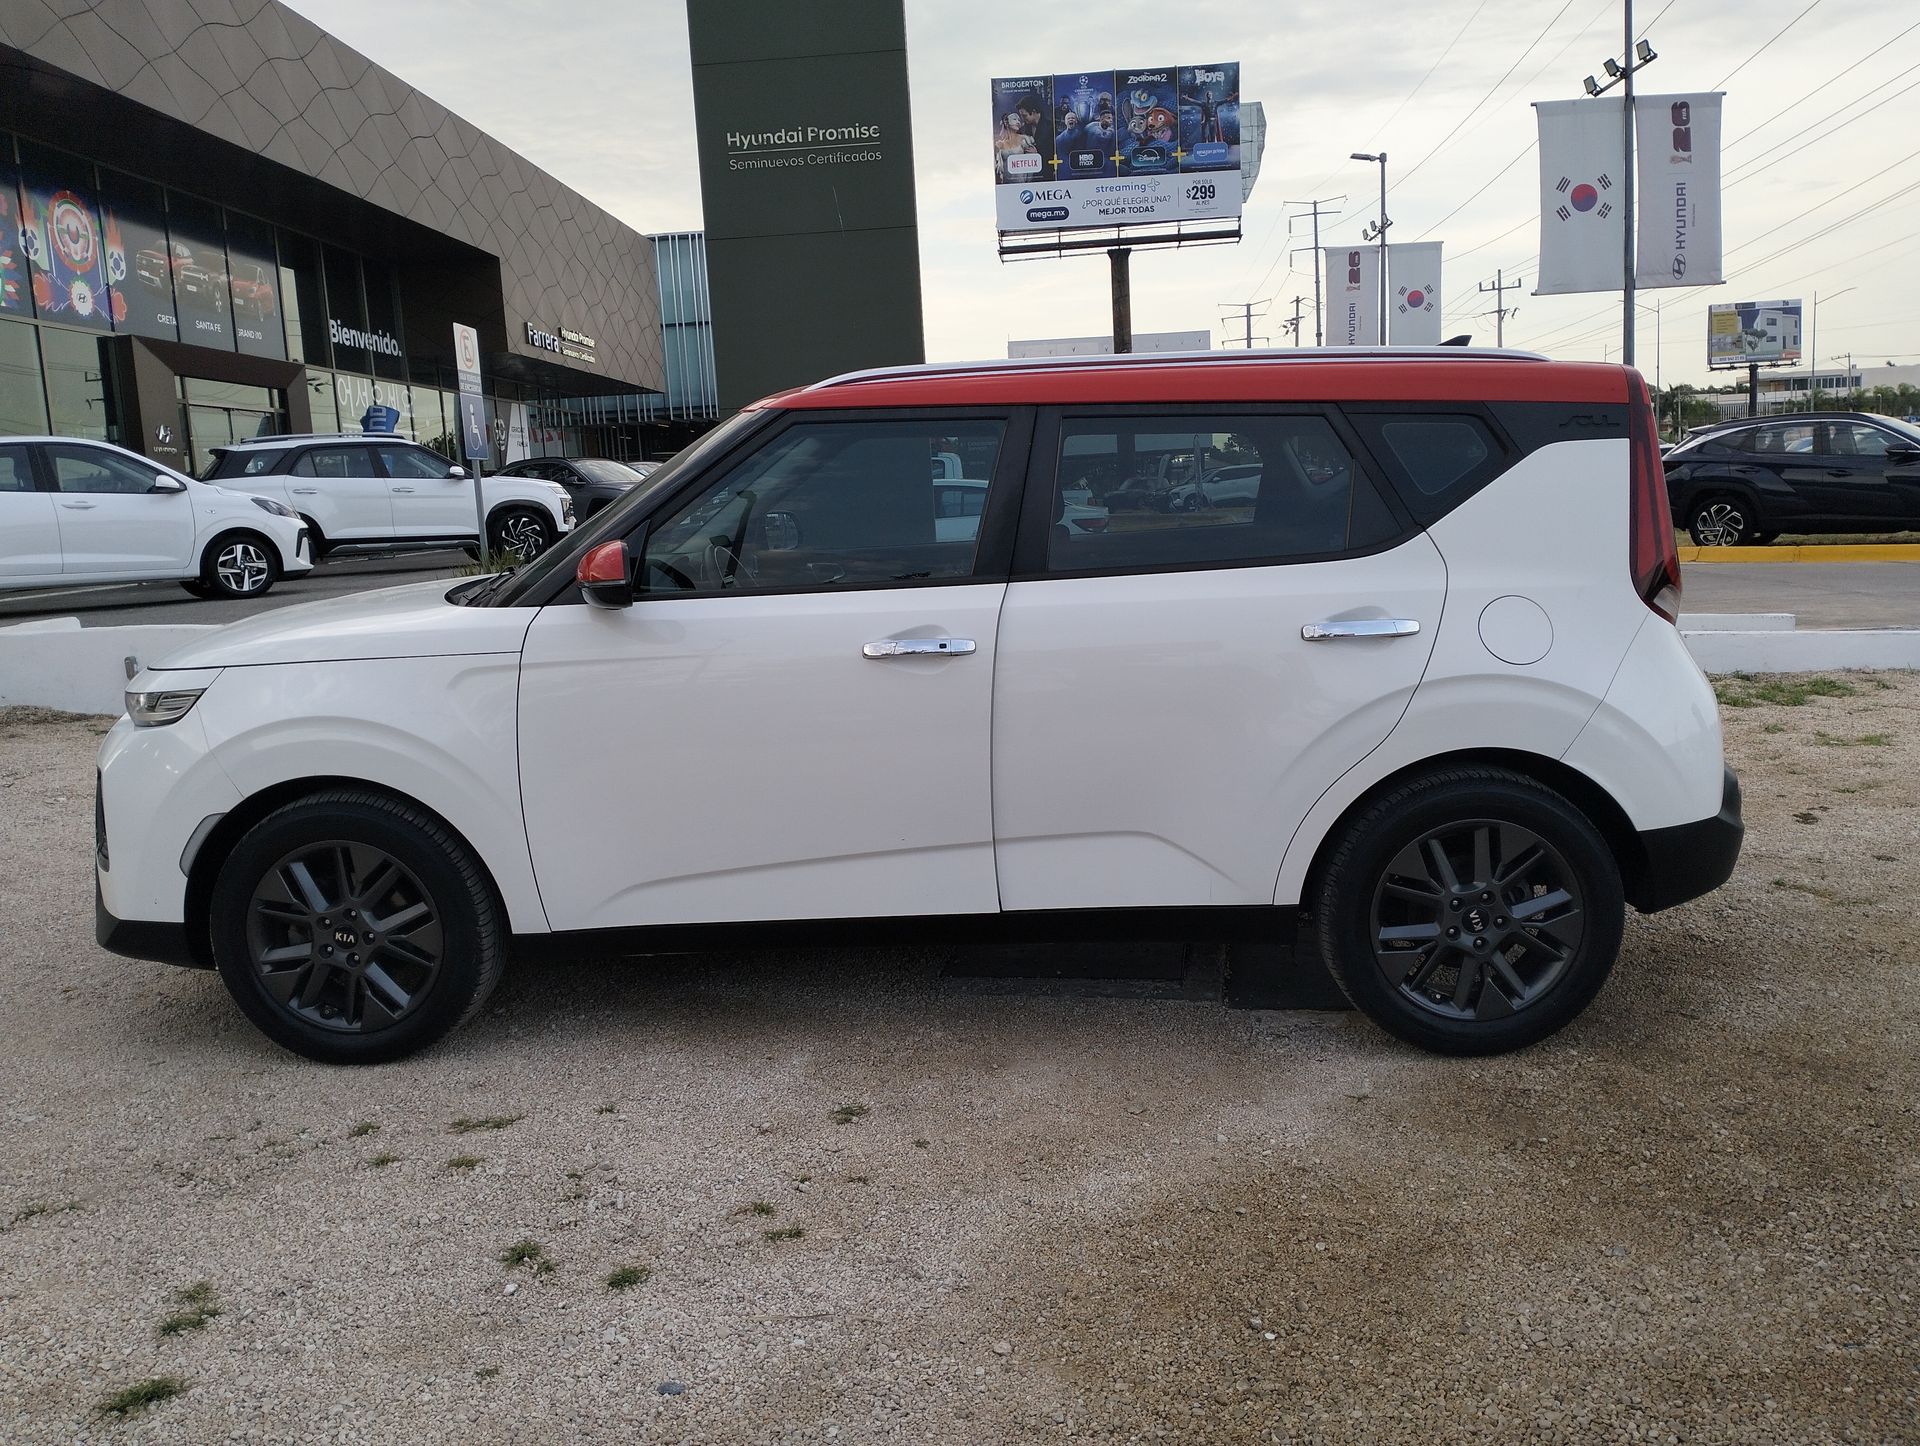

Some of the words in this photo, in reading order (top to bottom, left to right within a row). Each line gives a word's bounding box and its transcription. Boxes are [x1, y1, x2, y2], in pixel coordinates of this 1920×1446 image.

[1001, 80, 1044, 89] BRIDGERTON
[726, 126, 803, 150] Hyundai
[807, 122, 881, 142] Promise
[729, 156, 804, 170] Seminuevos
[807, 150, 882, 166] Certificados
[1011, 160, 1039, 169] NETFLIX
[1095, 182, 1147, 193] streaming
[1186, 184, 1216, 200] $299
[1034, 189, 1072, 201] MEGA
[1081, 199, 1103, 209] ¿POR
[1122, 196, 1149, 205] ELEGIR
[1150, 194, 1171, 203] UNA?
[1030, 209, 1066, 219] mega.mx
[1098, 206, 1127, 216] MEJOR
[1128, 205, 1155, 214] TODAS
[1675, 182, 1687, 250] HYUNDAI
[157, 313, 177, 326] CRETA
[195, 320, 214, 331] SANTA
[214, 323, 221, 333] FE
[1348, 302, 1356, 345] HYUNDAI
[329, 319, 402, 357] Bienvenido.
[527, 321, 560, 353] Farrera
[1469, 909, 1484, 931] KIA
[335, 932, 355, 943] KIA
